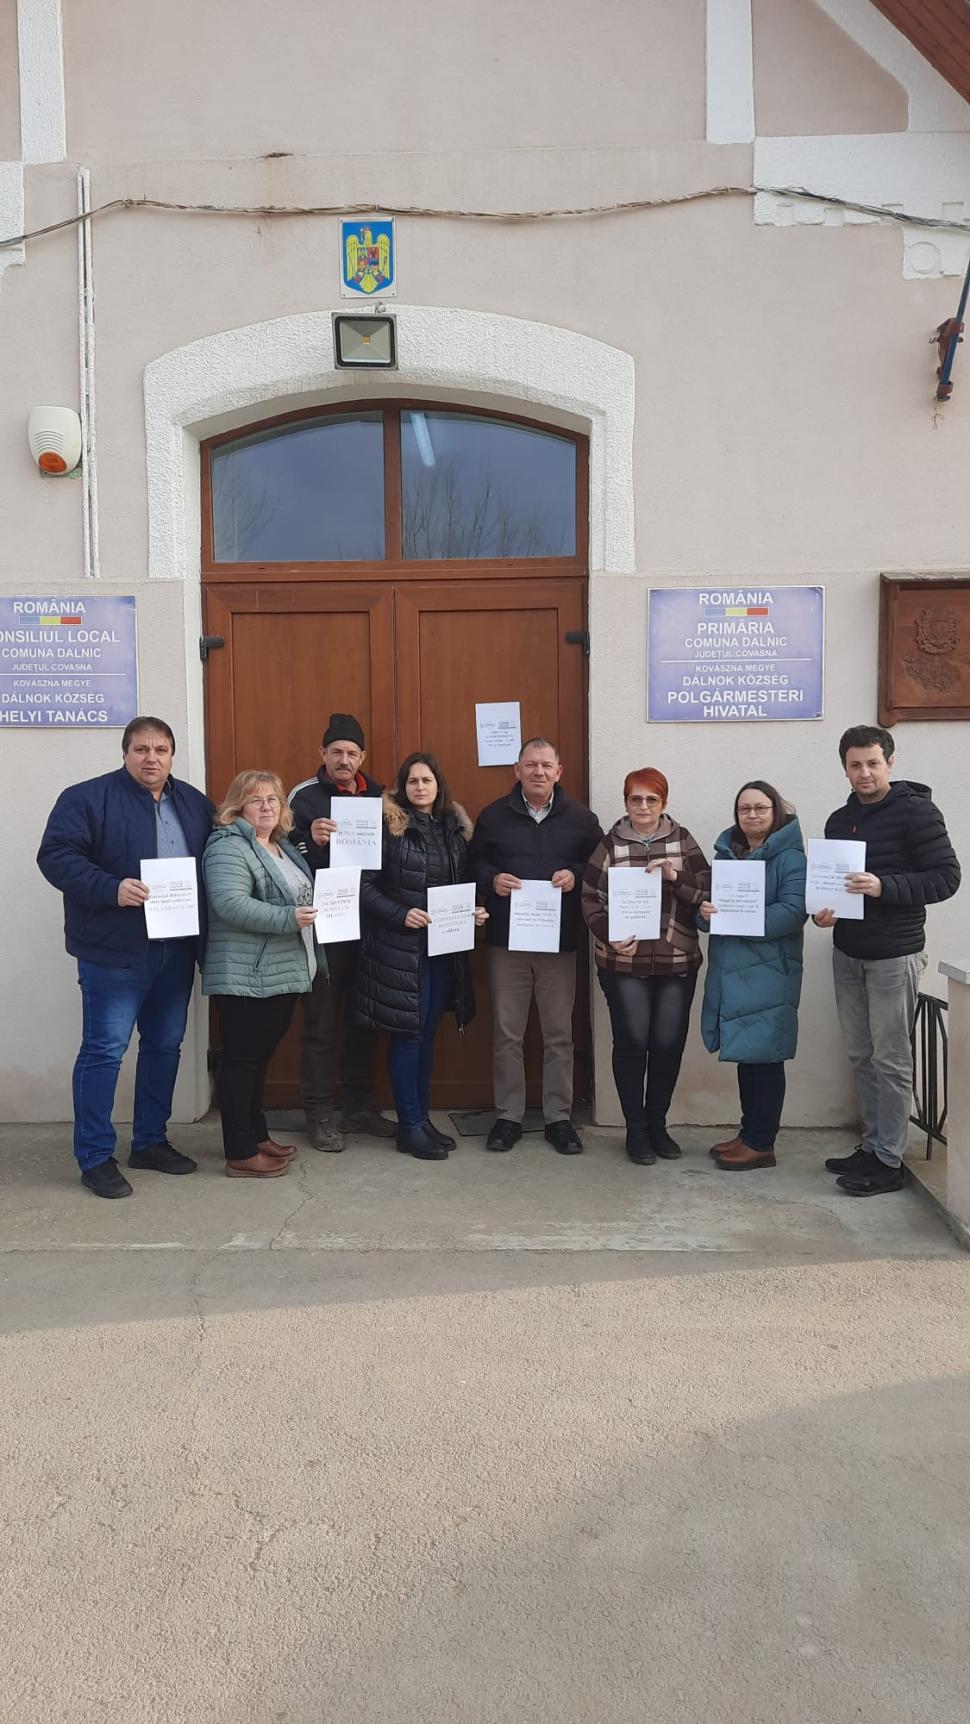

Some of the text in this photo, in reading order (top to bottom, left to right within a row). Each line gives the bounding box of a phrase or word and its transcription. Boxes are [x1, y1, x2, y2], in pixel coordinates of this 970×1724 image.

[699, 590, 774, 605] ROMÂNIA
[13, 598, 86, 613] ROMÂNIA
[697, 619, 774, 635] PRIMĂRIA
[68, 630, 120, 643] LOCAL
[685, 636, 787, 648] COMUNA DALNIC
[1, 648, 101, 658] COMUNA DALNIC
[736, 649, 777, 657] COVASNA
[52, 663, 92, 671] COVASNA
[745, 664, 776, 672] MEGYE
[682, 673, 789, 686] DÁLNOK KÖZSÉG
[2, 691, 51, 703] DÁLNOK
[667, 688, 804, 704] POLGÁRMESTERI
[0, 707, 108, 722] HELYI TANÁCS
[703, 705, 768, 717] HIVATAL
